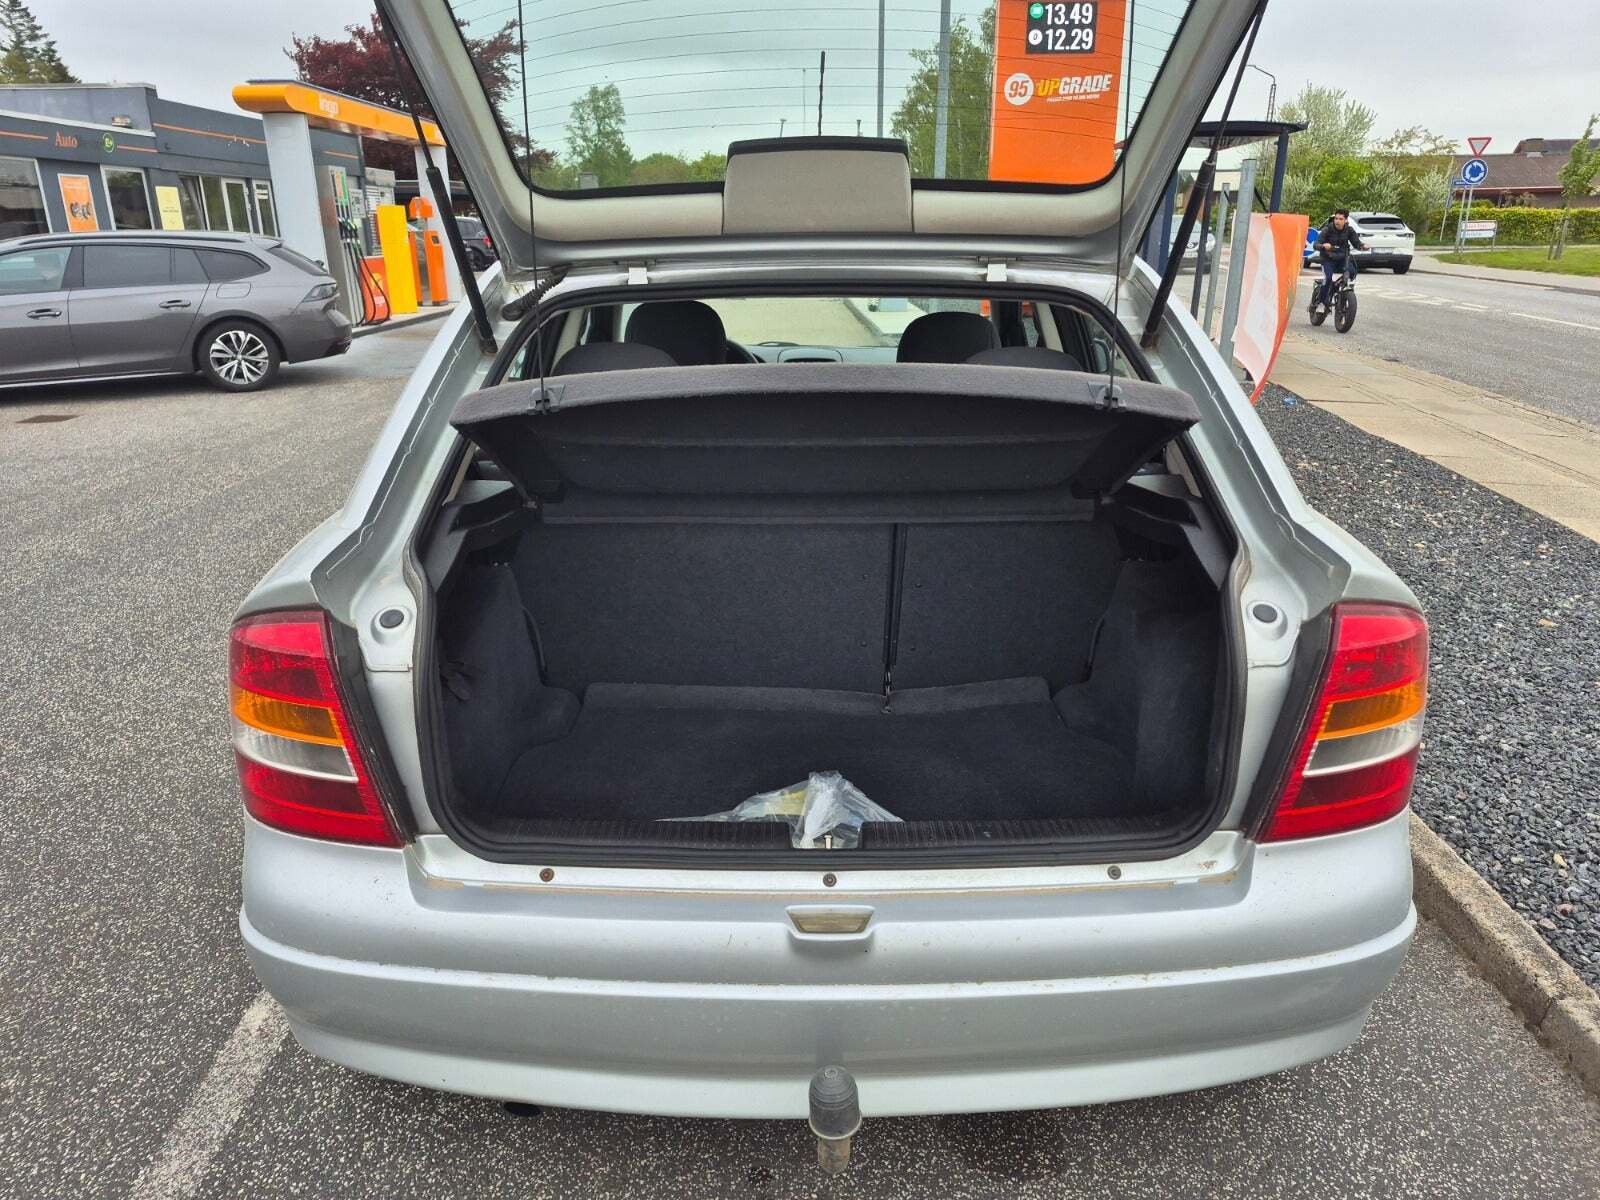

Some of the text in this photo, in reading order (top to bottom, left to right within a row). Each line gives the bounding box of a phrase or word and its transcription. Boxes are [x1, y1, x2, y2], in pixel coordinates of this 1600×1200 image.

[1045, 3, 1093, 25] 13.49
[1046, 28, 1093, 50] 12.29
[1009, 80, 1029, 99] 95
[55, 131, 78, 148] Auto
